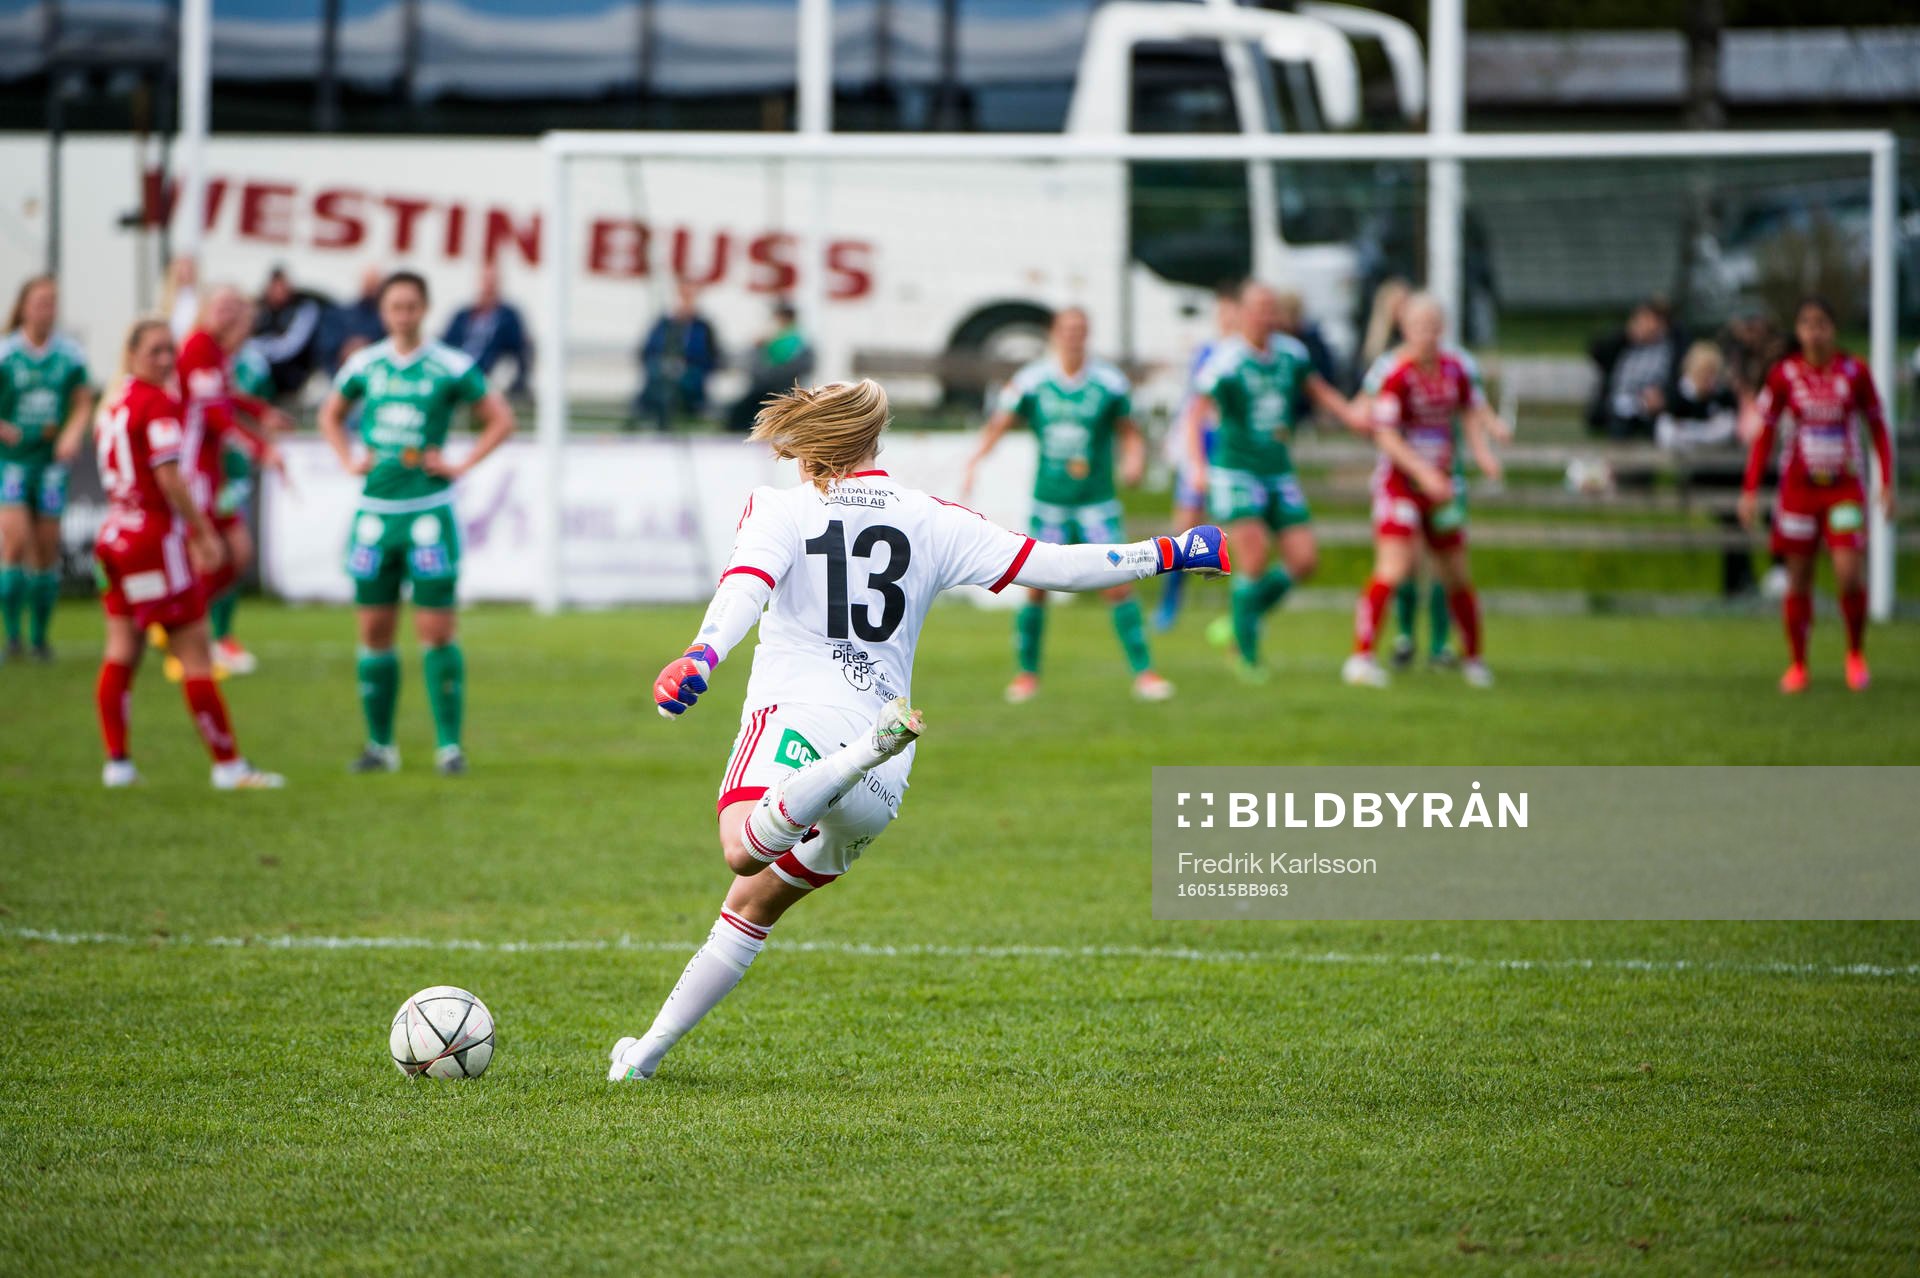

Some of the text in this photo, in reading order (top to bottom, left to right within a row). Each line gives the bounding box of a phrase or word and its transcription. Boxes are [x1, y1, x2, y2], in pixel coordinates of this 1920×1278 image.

[589, 217, 873, 300] BUSS
[870, 498, 886, 506] AB
[805, 520, 911, 642] 13
